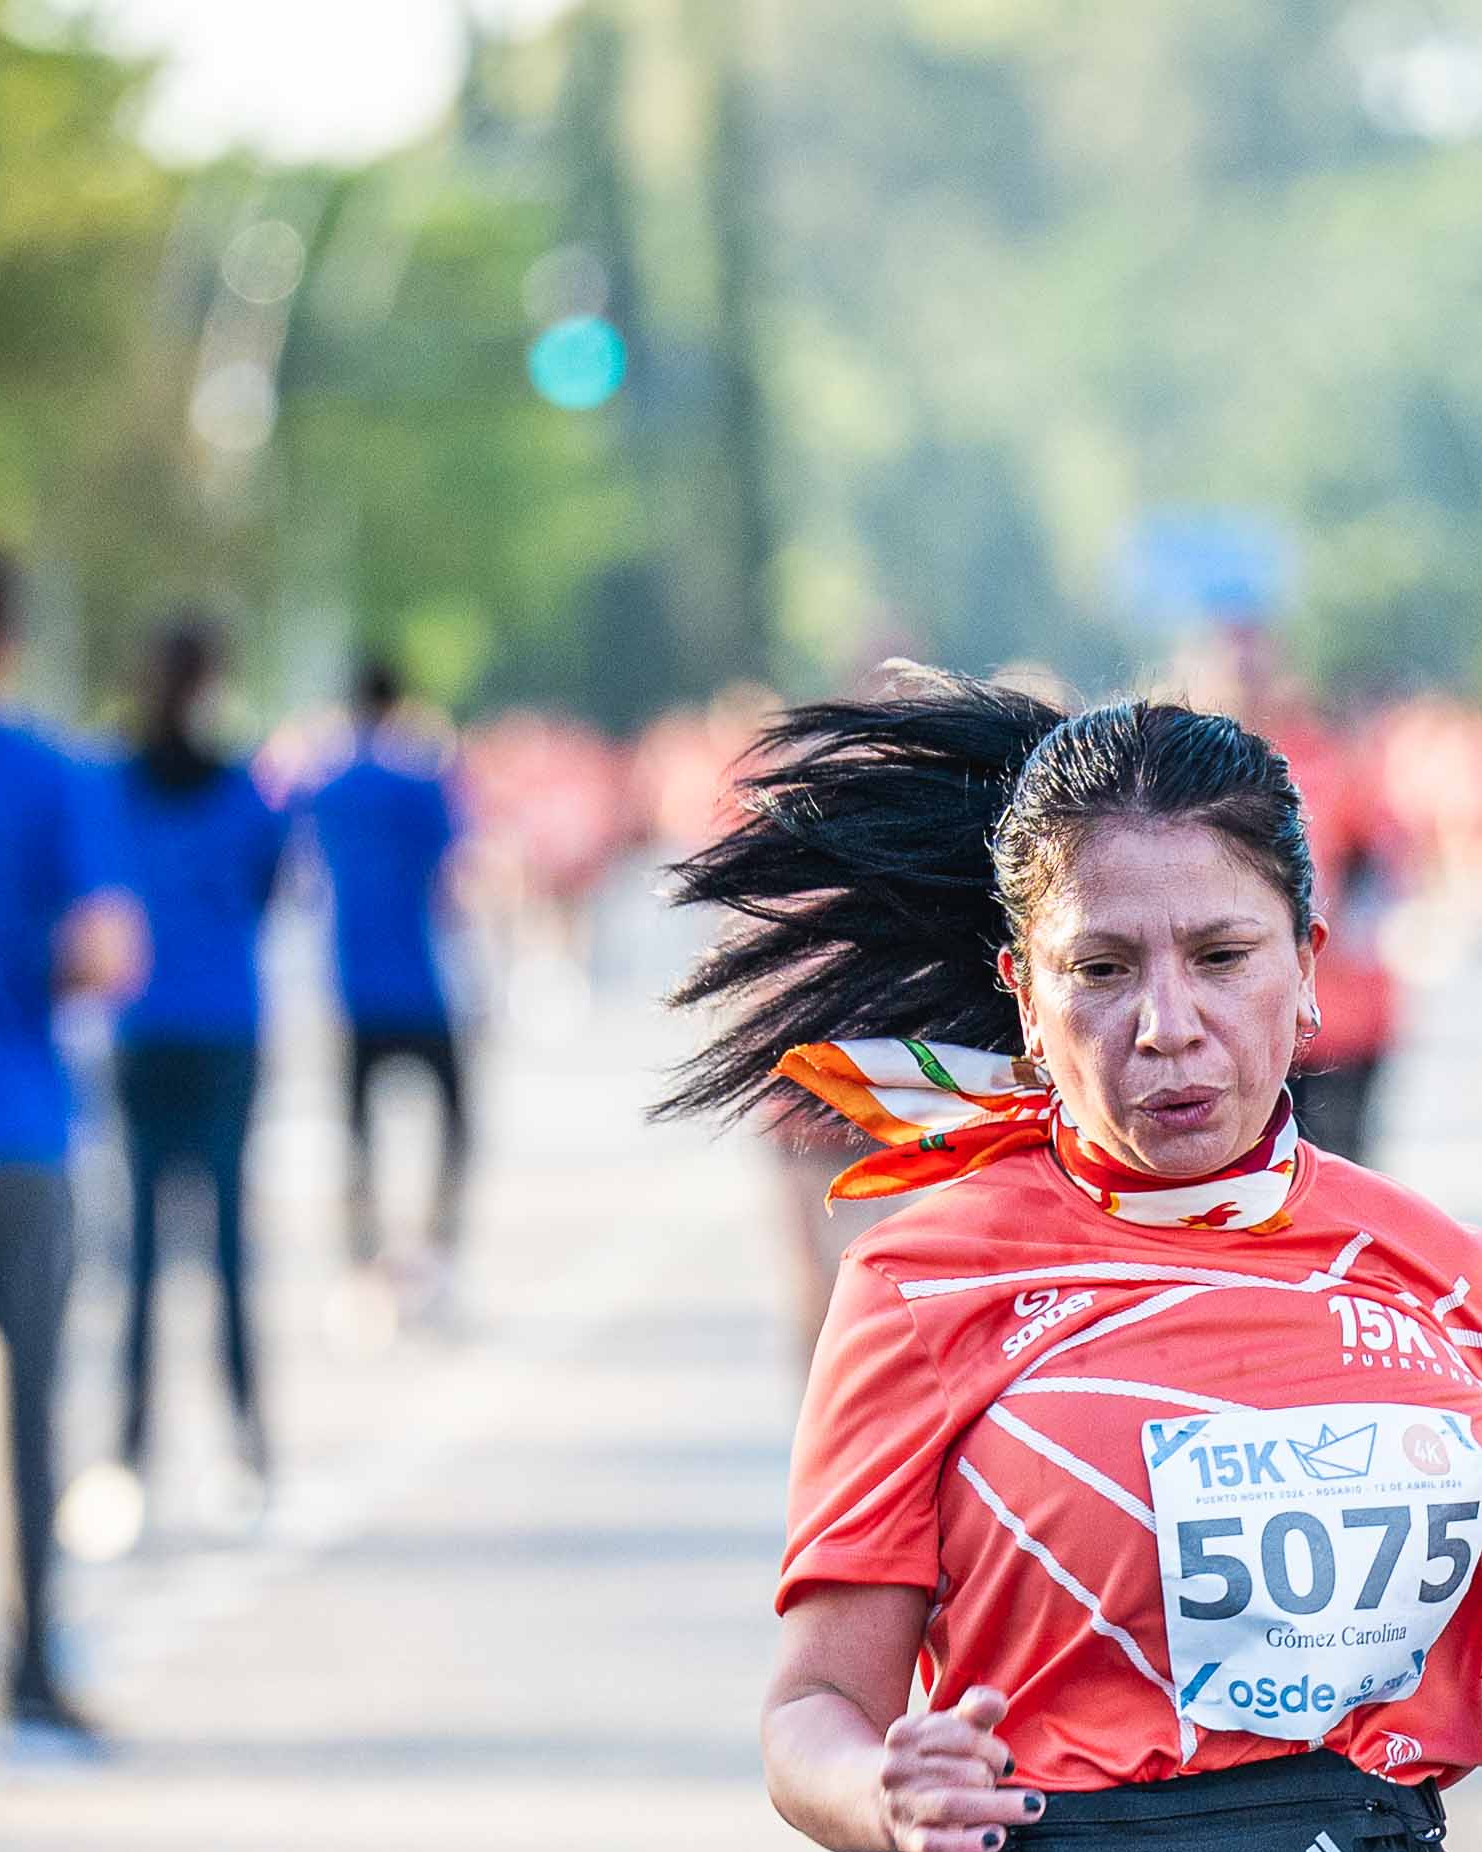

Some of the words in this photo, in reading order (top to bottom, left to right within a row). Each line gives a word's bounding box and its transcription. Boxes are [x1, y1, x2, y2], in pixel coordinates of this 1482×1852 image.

[1328, 1294, 1437, 1359] 15K
[1342, 1352, 1444, 1376] PUERTO
[1189, 1439, 1286, 1489] 15K
[1176, 1500, 1480, 1622] 5075
[1266, 1626, 1337, 1649] Gómez
[1342, 1623, 1407, 1647] Carolina
[1228, 1674, 1336, 1714] osde
